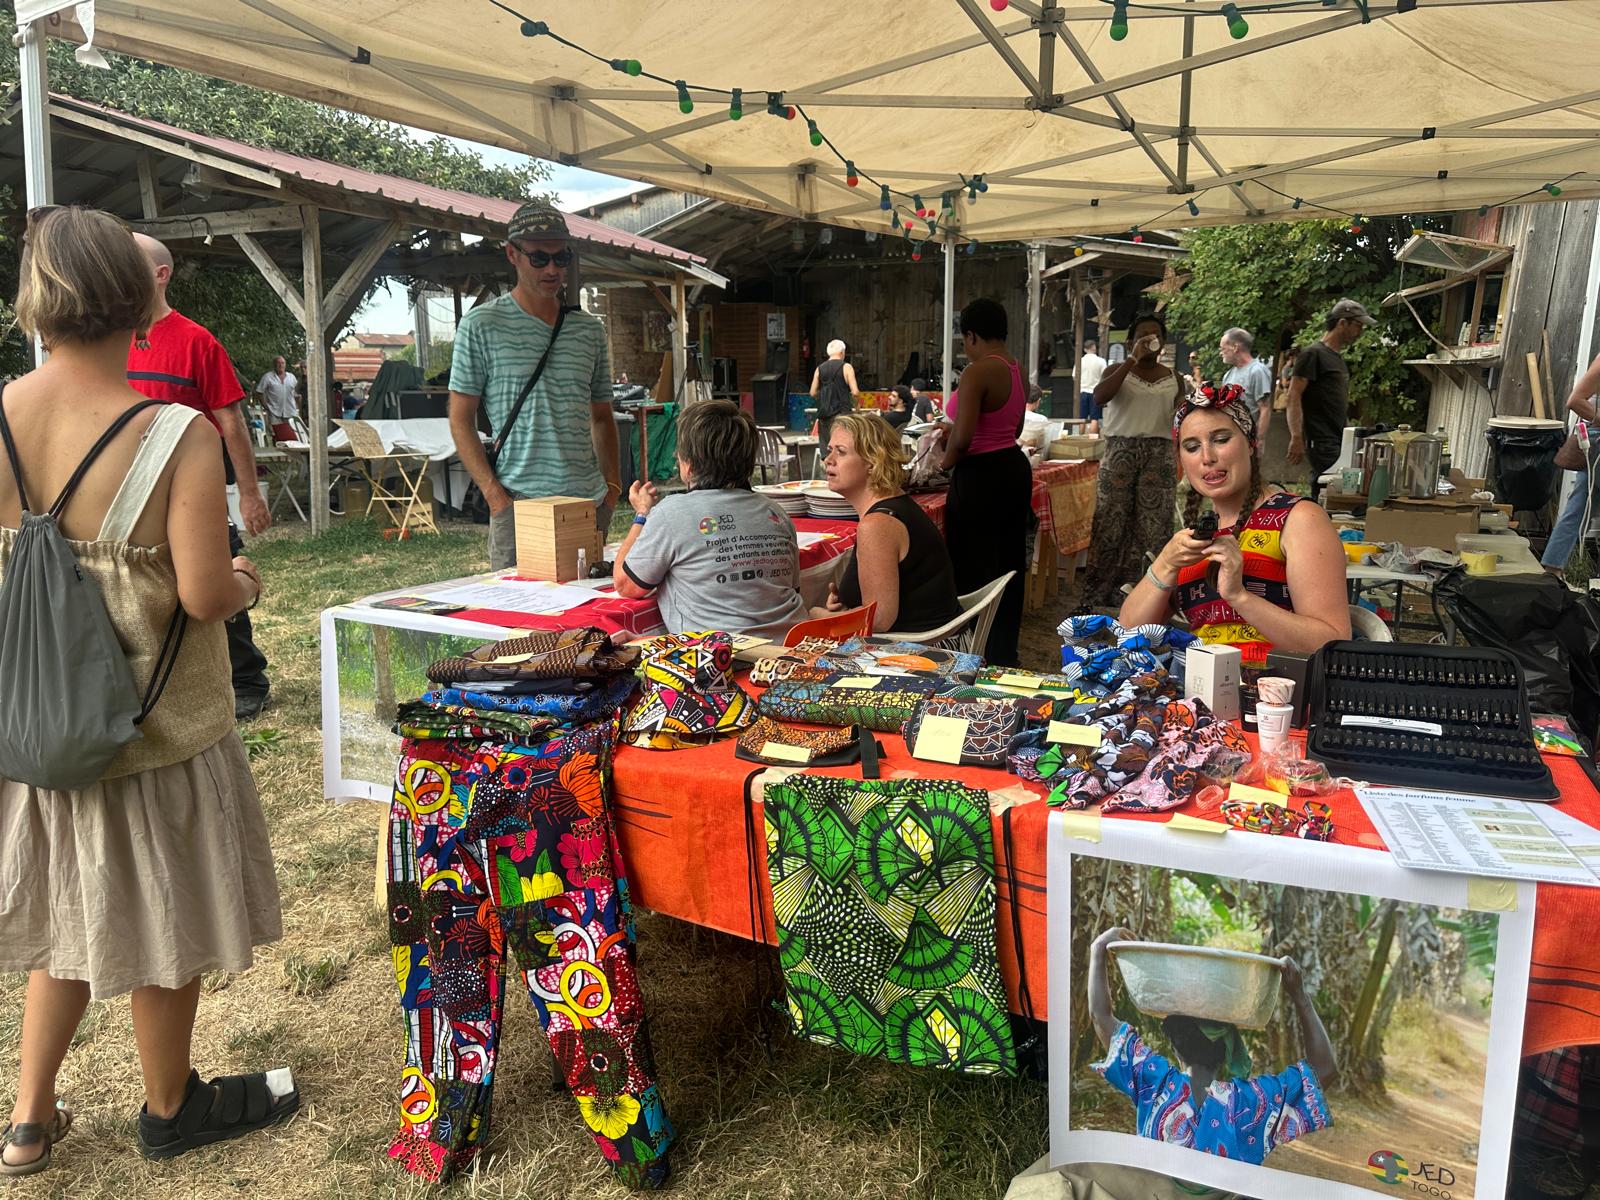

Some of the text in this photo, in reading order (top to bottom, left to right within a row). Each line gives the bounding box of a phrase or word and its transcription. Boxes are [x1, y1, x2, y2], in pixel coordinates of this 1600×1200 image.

[718, 515, 734, 524] JED
[706, 537, 729, 547] Projet
[735, 542, 764, 550] femmes
[715, 555, 731, 563] des
[733, 551, 760, 559] enfants
[770, 569, 780, 578] JED
[1411, 1162, 1455, 1186] JED
[1412, 1180, 1451, 1200] TOGO
